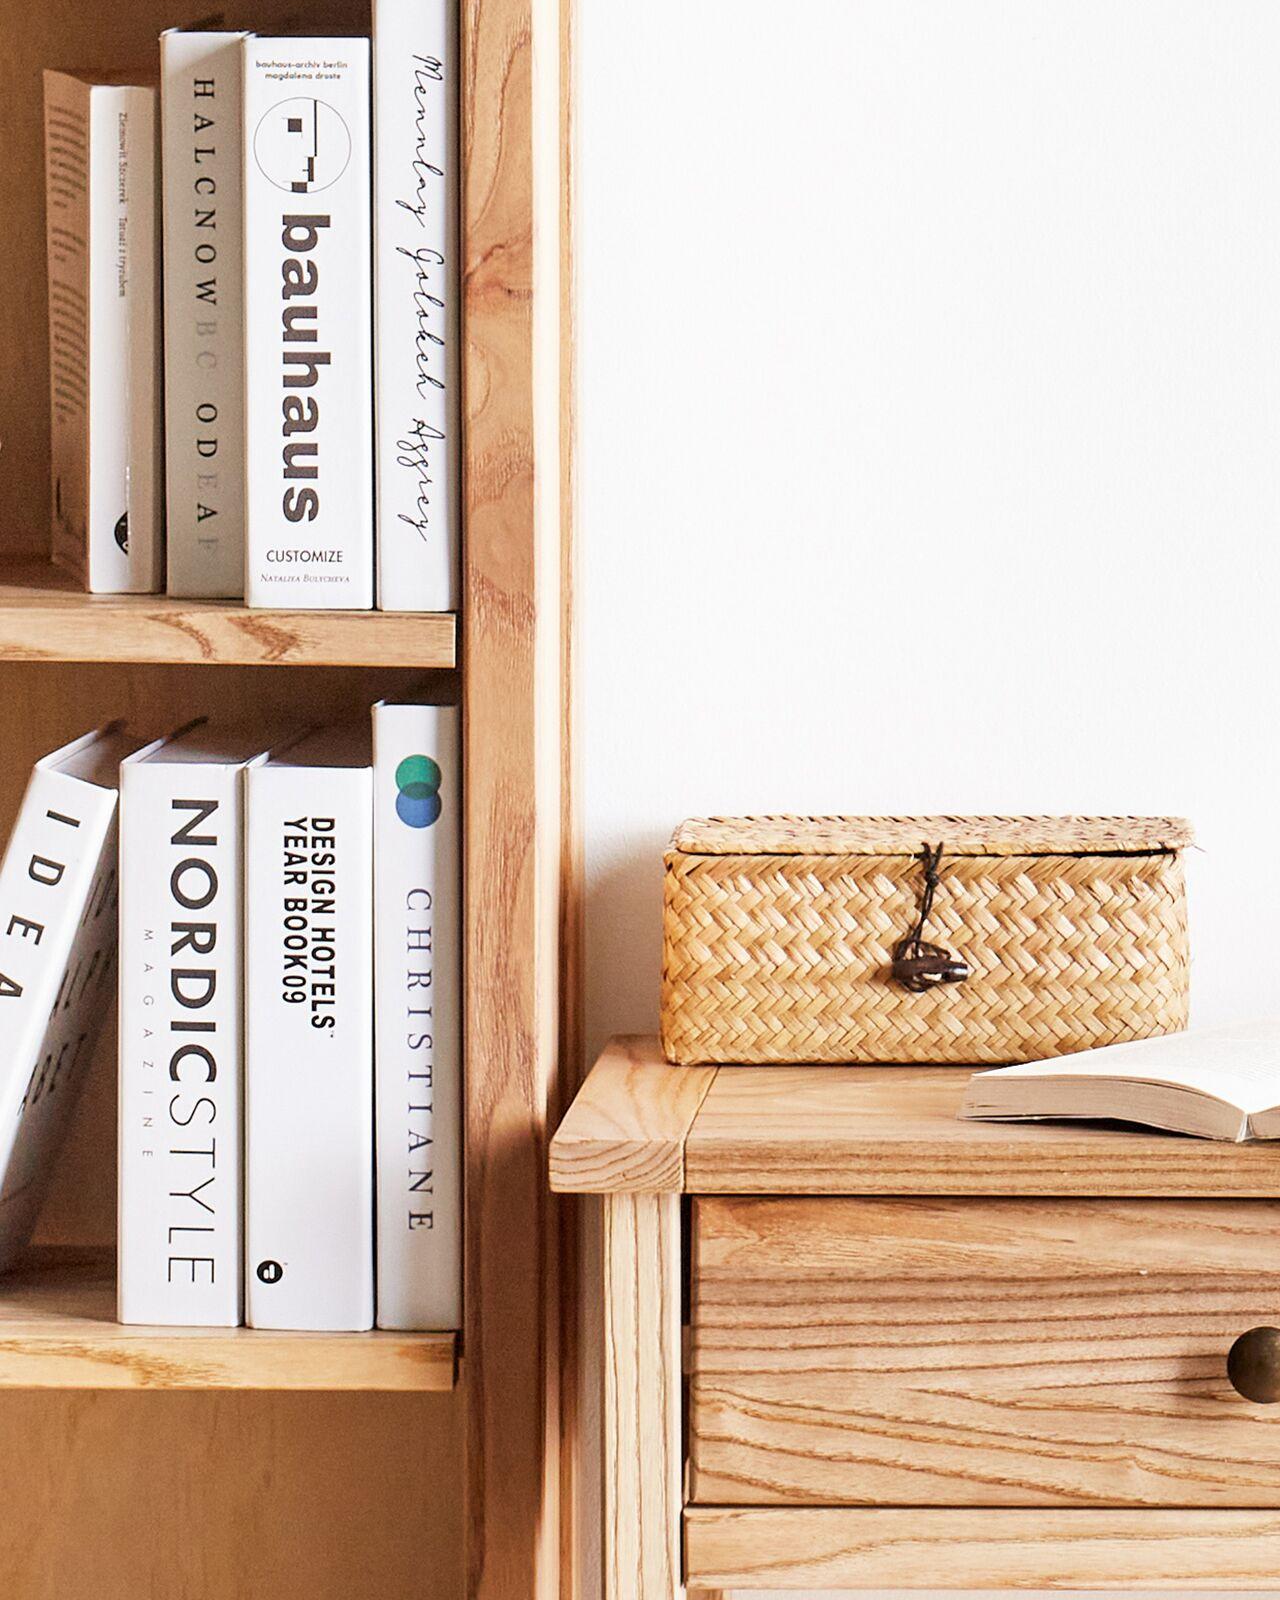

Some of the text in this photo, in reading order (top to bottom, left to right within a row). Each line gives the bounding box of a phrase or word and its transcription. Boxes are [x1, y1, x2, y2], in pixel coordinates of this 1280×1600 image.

[255, 60, 348, 69] bauhaus-archiv berlin
[264, 72, 341, 81] magdalena droste
[281, 214, 332, 523] bauhaus
[266, 549, 344, 563] CUSTOMIZE
[283, 816, 308, 885] YEAR
[311, 817, 336, 914] DESIGN
[142, 929, 154, 1158] MAGAZINE
[406, 888, 434, 1231] CHRISTIANE
